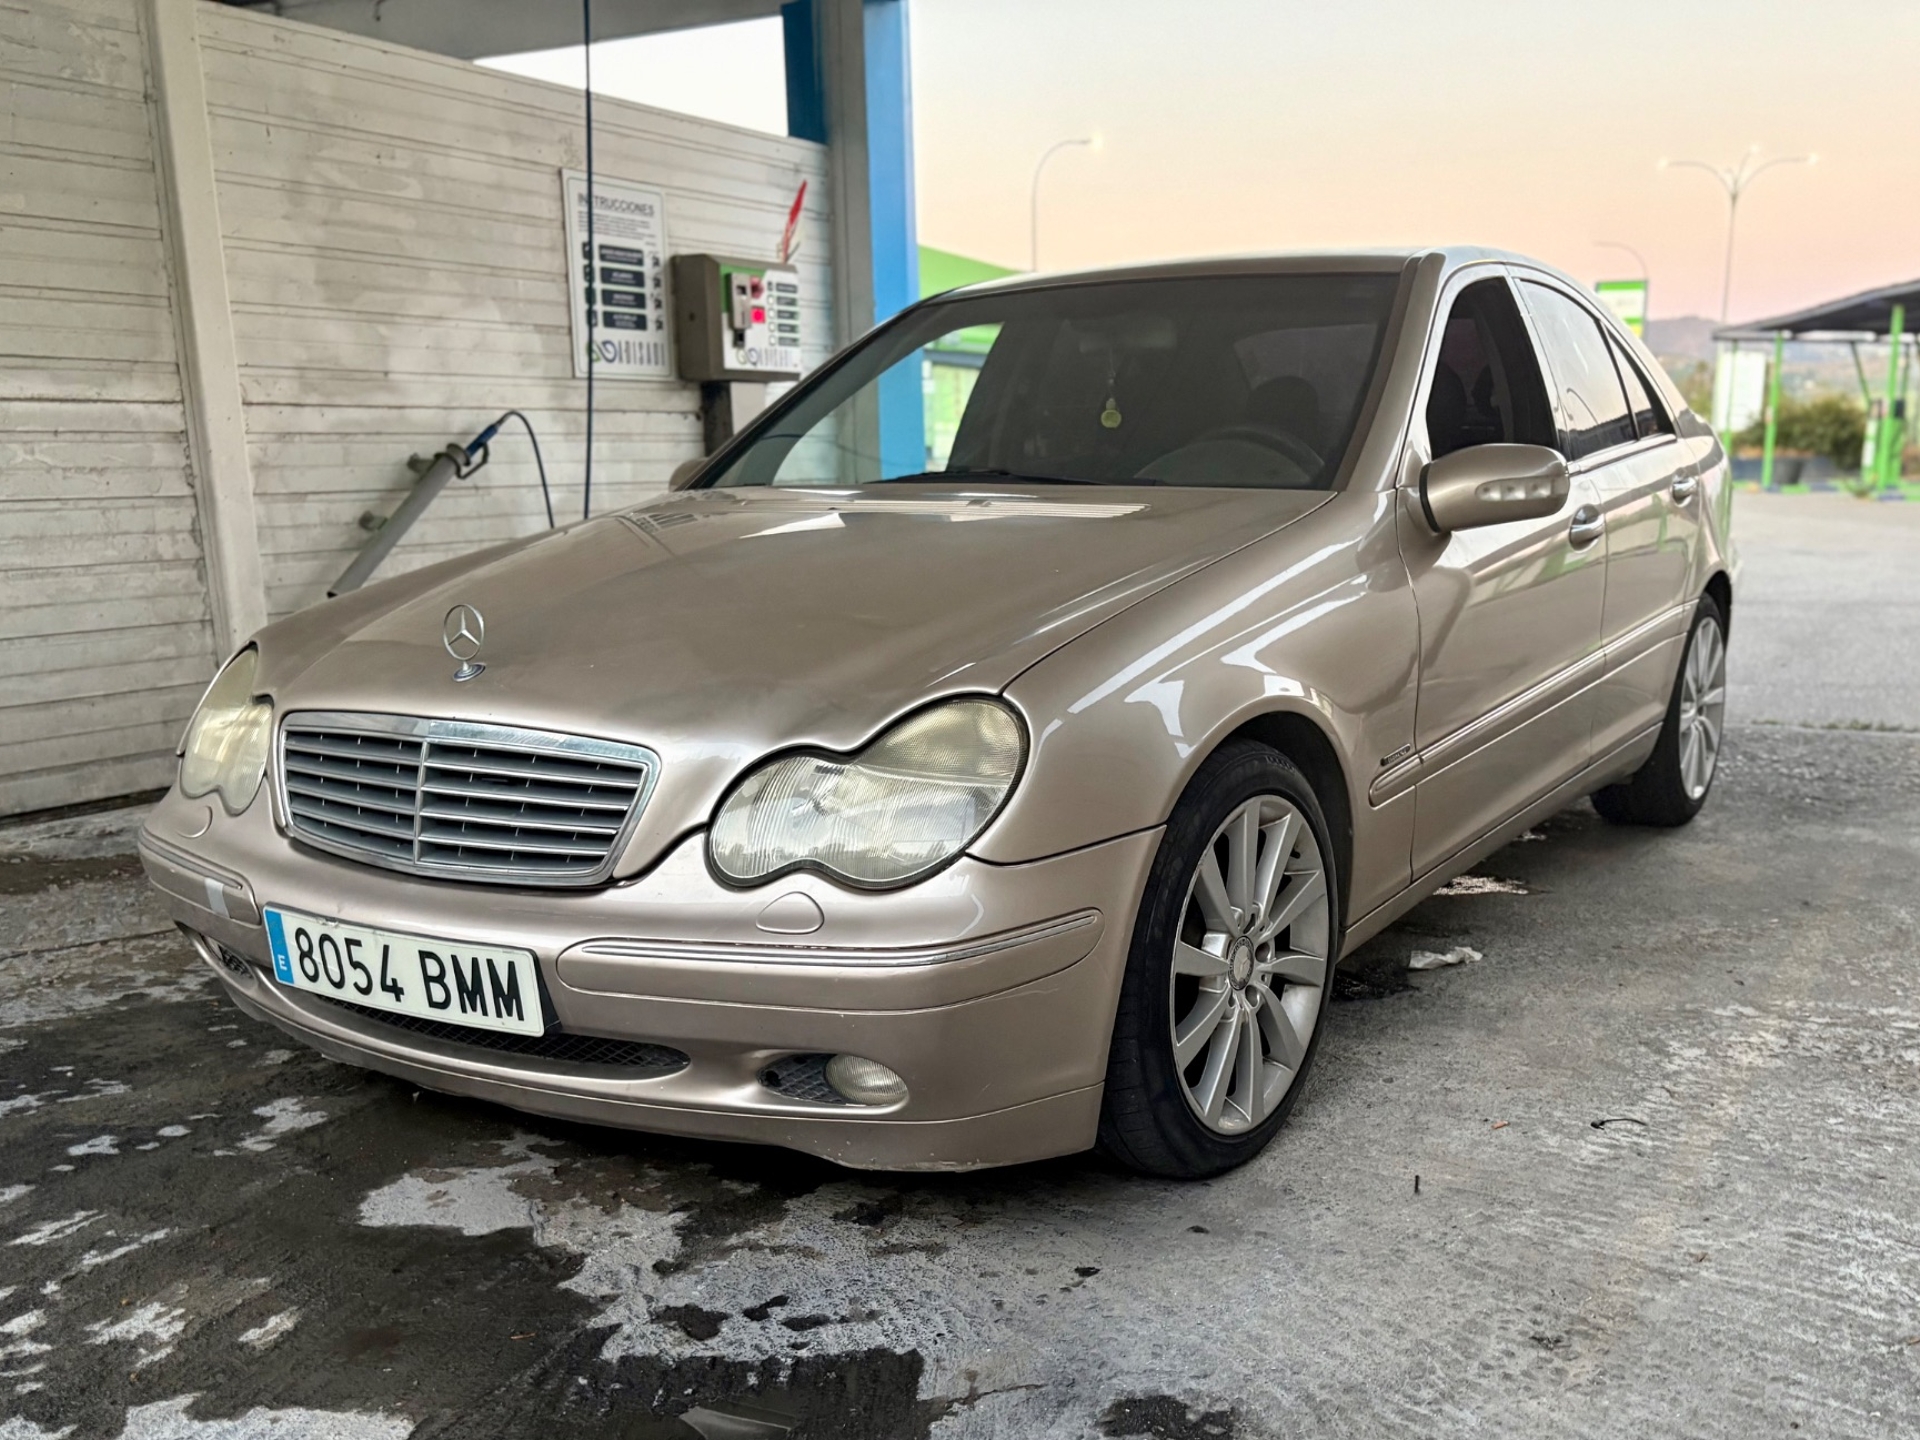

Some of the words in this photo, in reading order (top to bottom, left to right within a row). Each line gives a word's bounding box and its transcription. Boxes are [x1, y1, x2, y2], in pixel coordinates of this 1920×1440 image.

[577, 192, 655, 217] INTRUCCIONES
[277, 954, 288, 971] E
[294, 926, 405, 1003] 8054
[417, 949, 525, 1022] BMM
